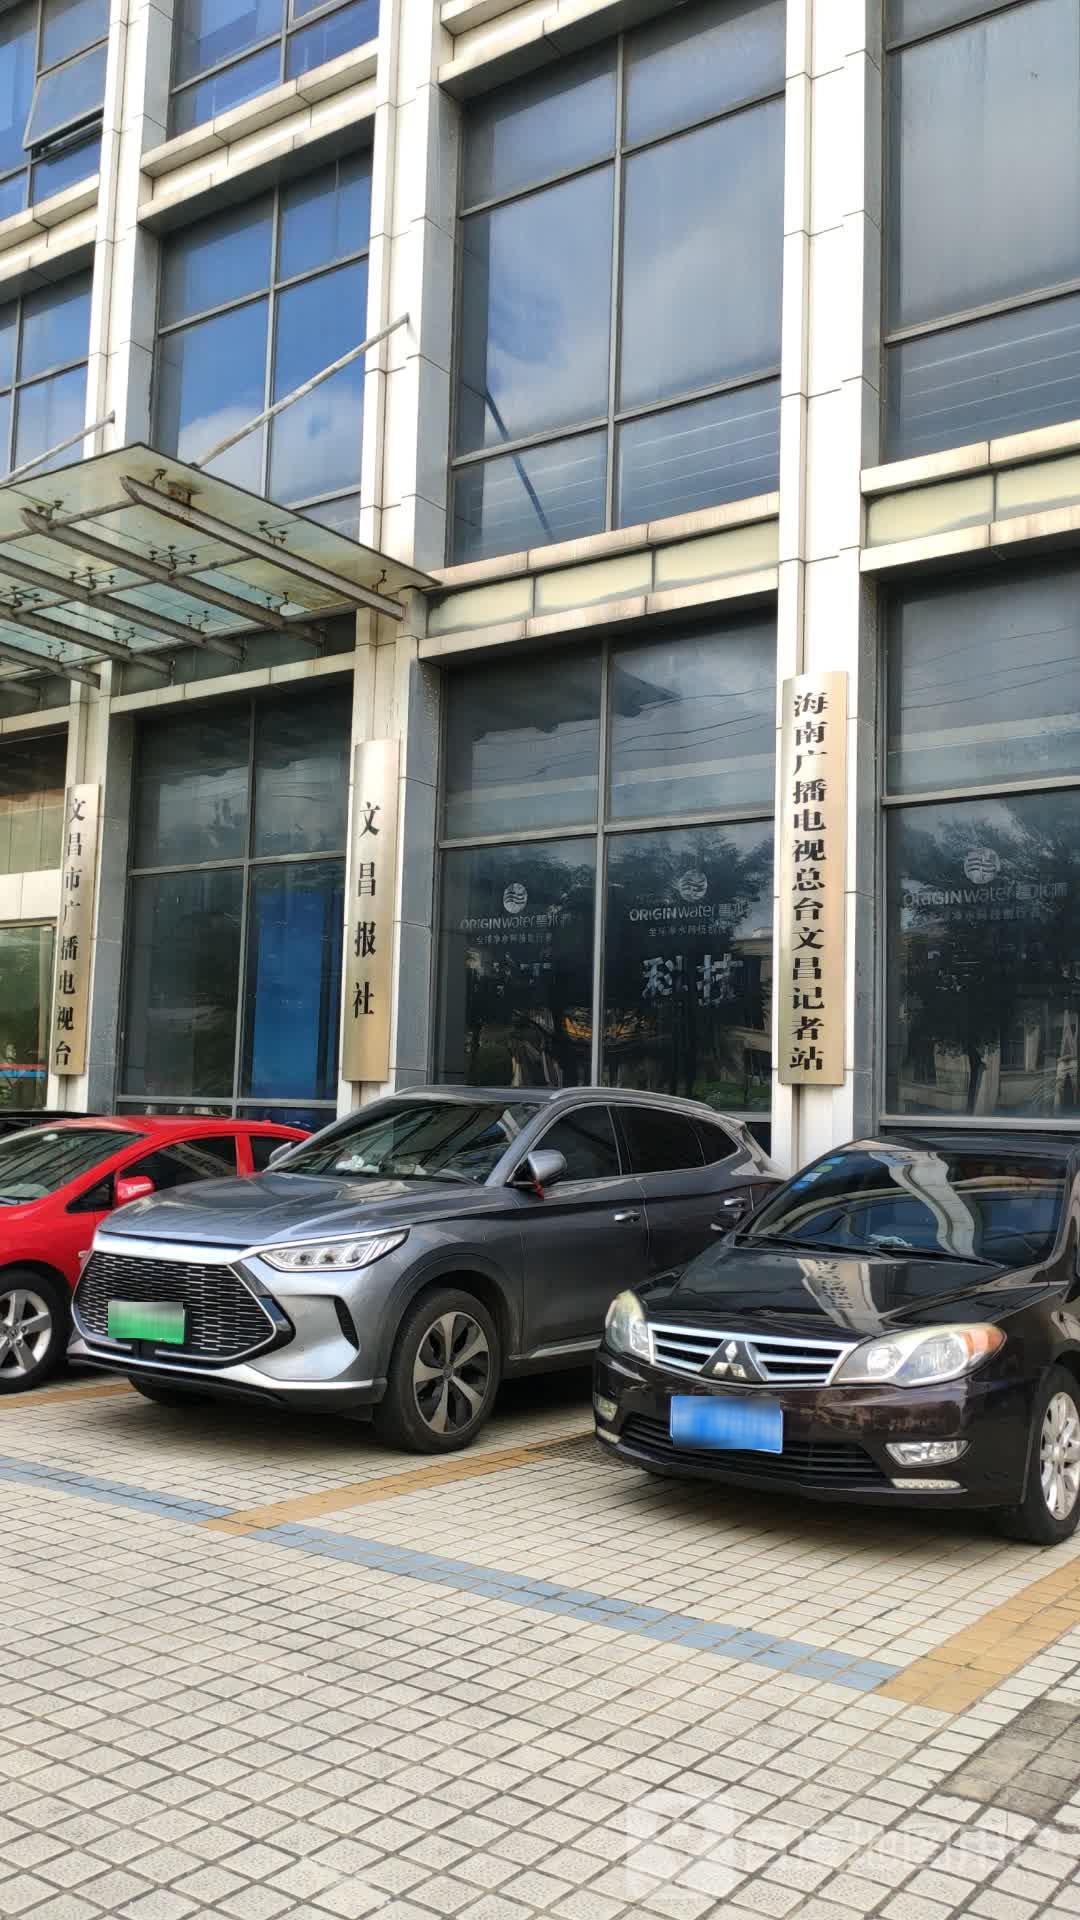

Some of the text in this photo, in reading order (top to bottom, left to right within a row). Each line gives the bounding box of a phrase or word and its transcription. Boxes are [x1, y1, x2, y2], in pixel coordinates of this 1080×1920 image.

[56, 798, 86, 1066] 文昌市广播电视台
[352, 801, 382, 1019] 文昌报社
[789, 692, 829, 1071] 海南广播电视总台文昌记者站
